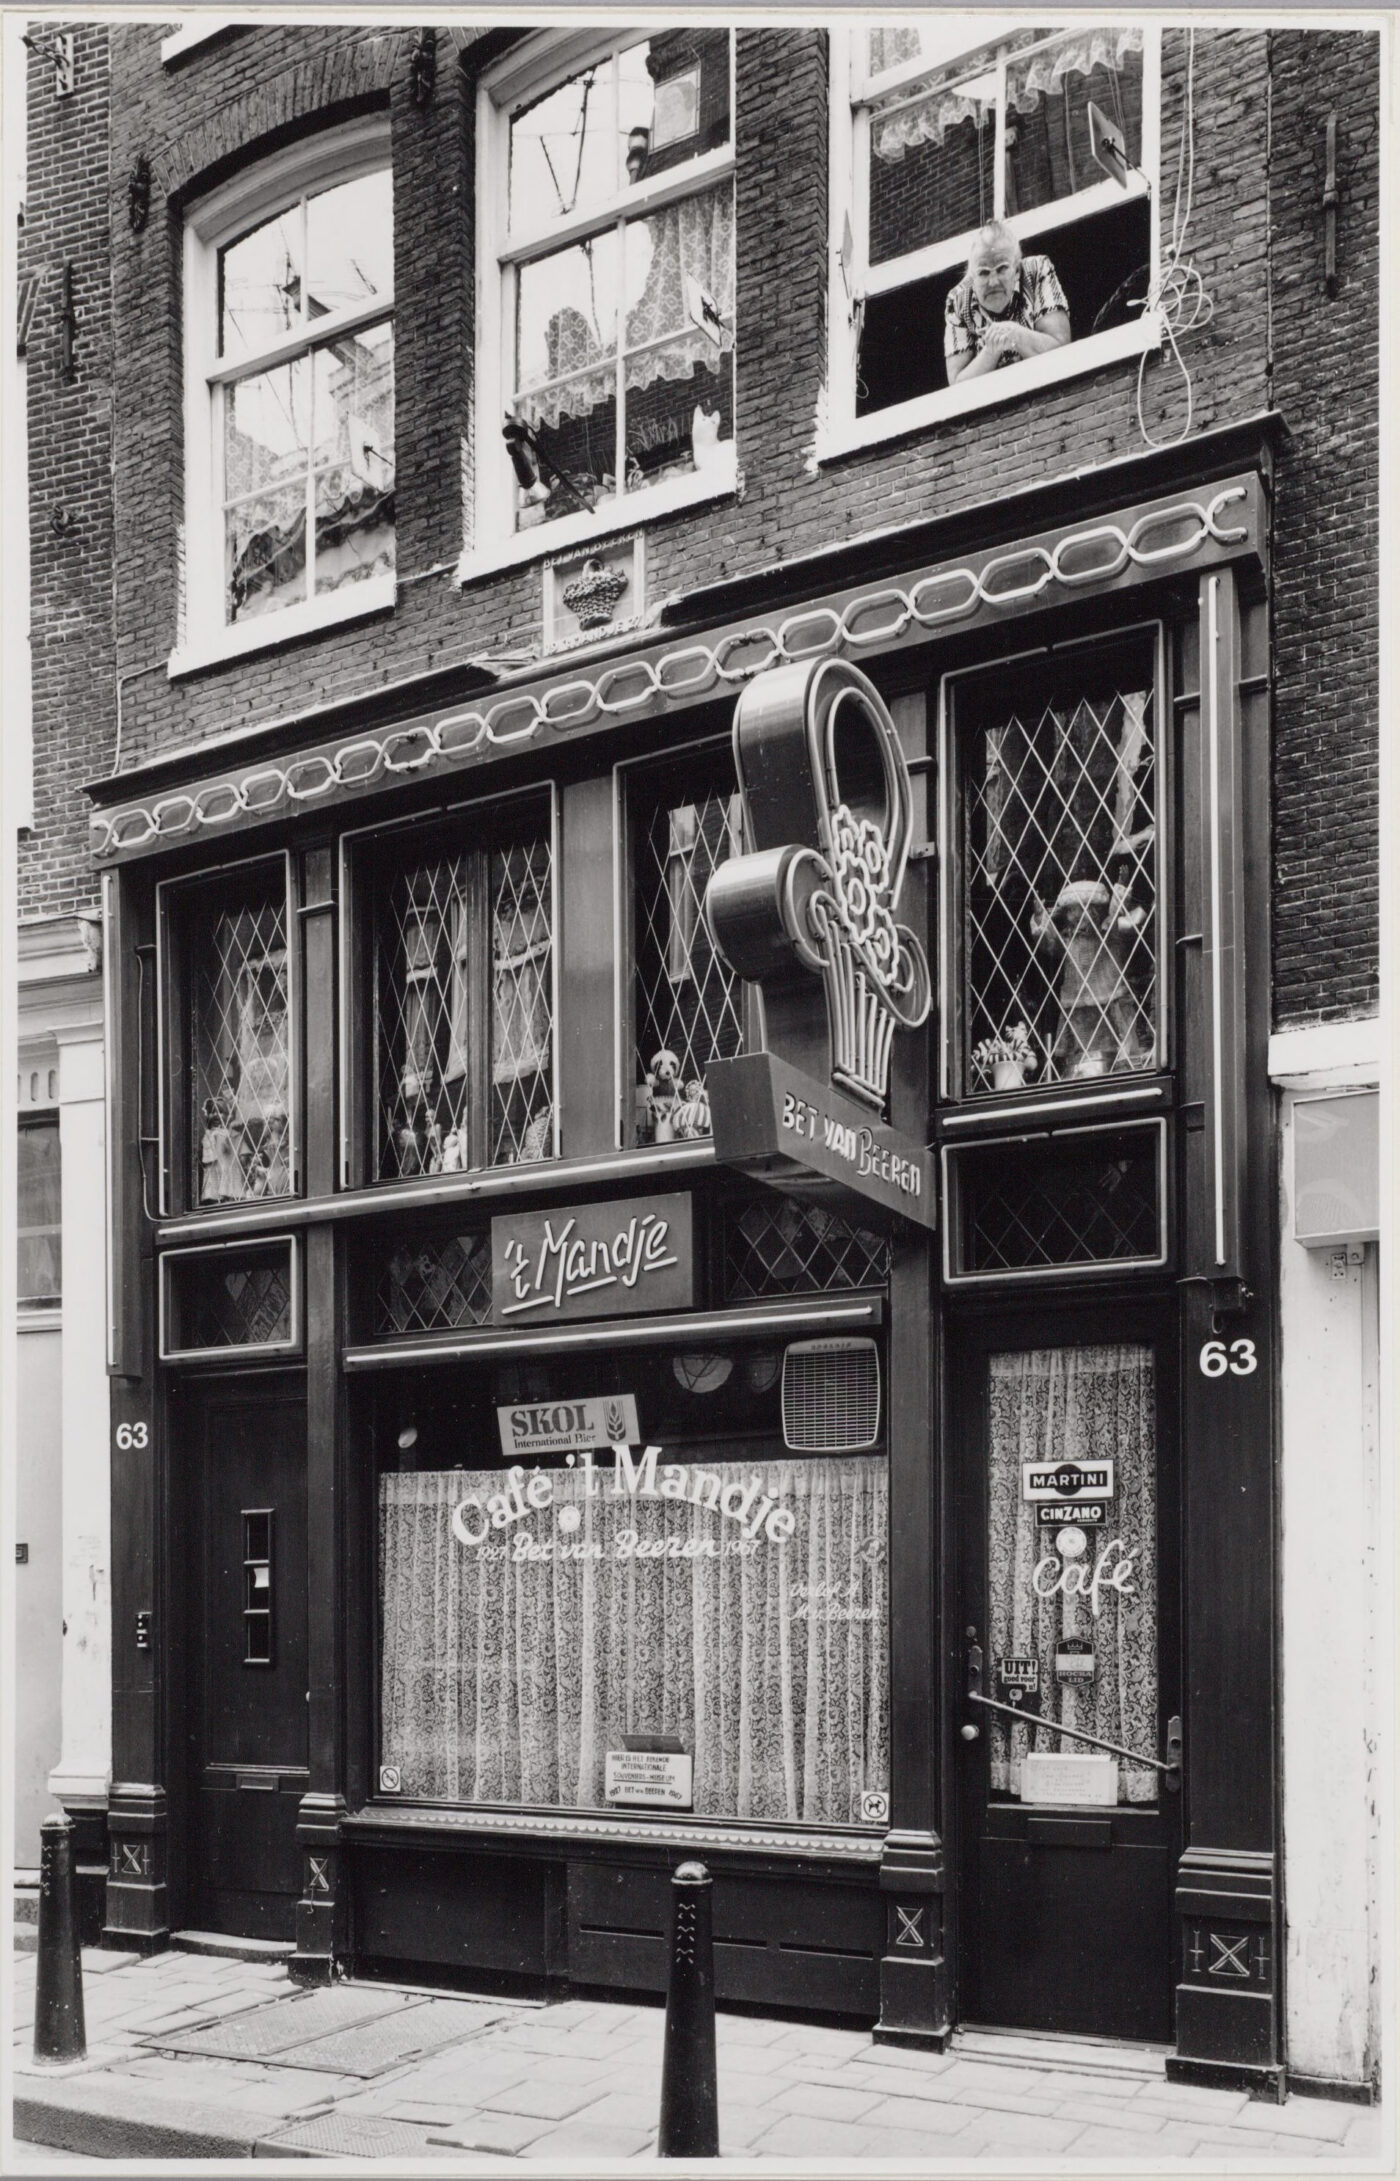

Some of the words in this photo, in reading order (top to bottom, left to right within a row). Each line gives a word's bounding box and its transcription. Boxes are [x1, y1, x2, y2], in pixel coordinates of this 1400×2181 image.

[782, 1091, 818, 1140] BET
[824, 1114, 857, 1161] VAN
[505, 1240, 531, 1299] 't
[535, 1214, 669, 1307] Mandje
[1200, 1339, 1258, 1378] 63
[116, 1421, 149, 1450] 63
[510, 1404, 595, 1438] SKOL
[514, 1434, 572, 1449] International
[575, 1433, 597, 1444] Bier
[452, 1465, 554, 1546] Café
[565, 1452, 599, 1497] 't
[610, 1444, 796, 1544] Mandje
[1033, 1473, 1104, 1487] MARTINI
[1040, 1506, 1101, 1521] CINZANO
[475, 1545, 508, 1560] 1927
[511, 1531, 553, 1562] Bet
[559, 1542, 605, 1560] van
[615, 1529, 722, 1559] Beeren
[724, 1539, 761, 1557] 1967
[1004, 1660, 1037, 1675] UIT!
